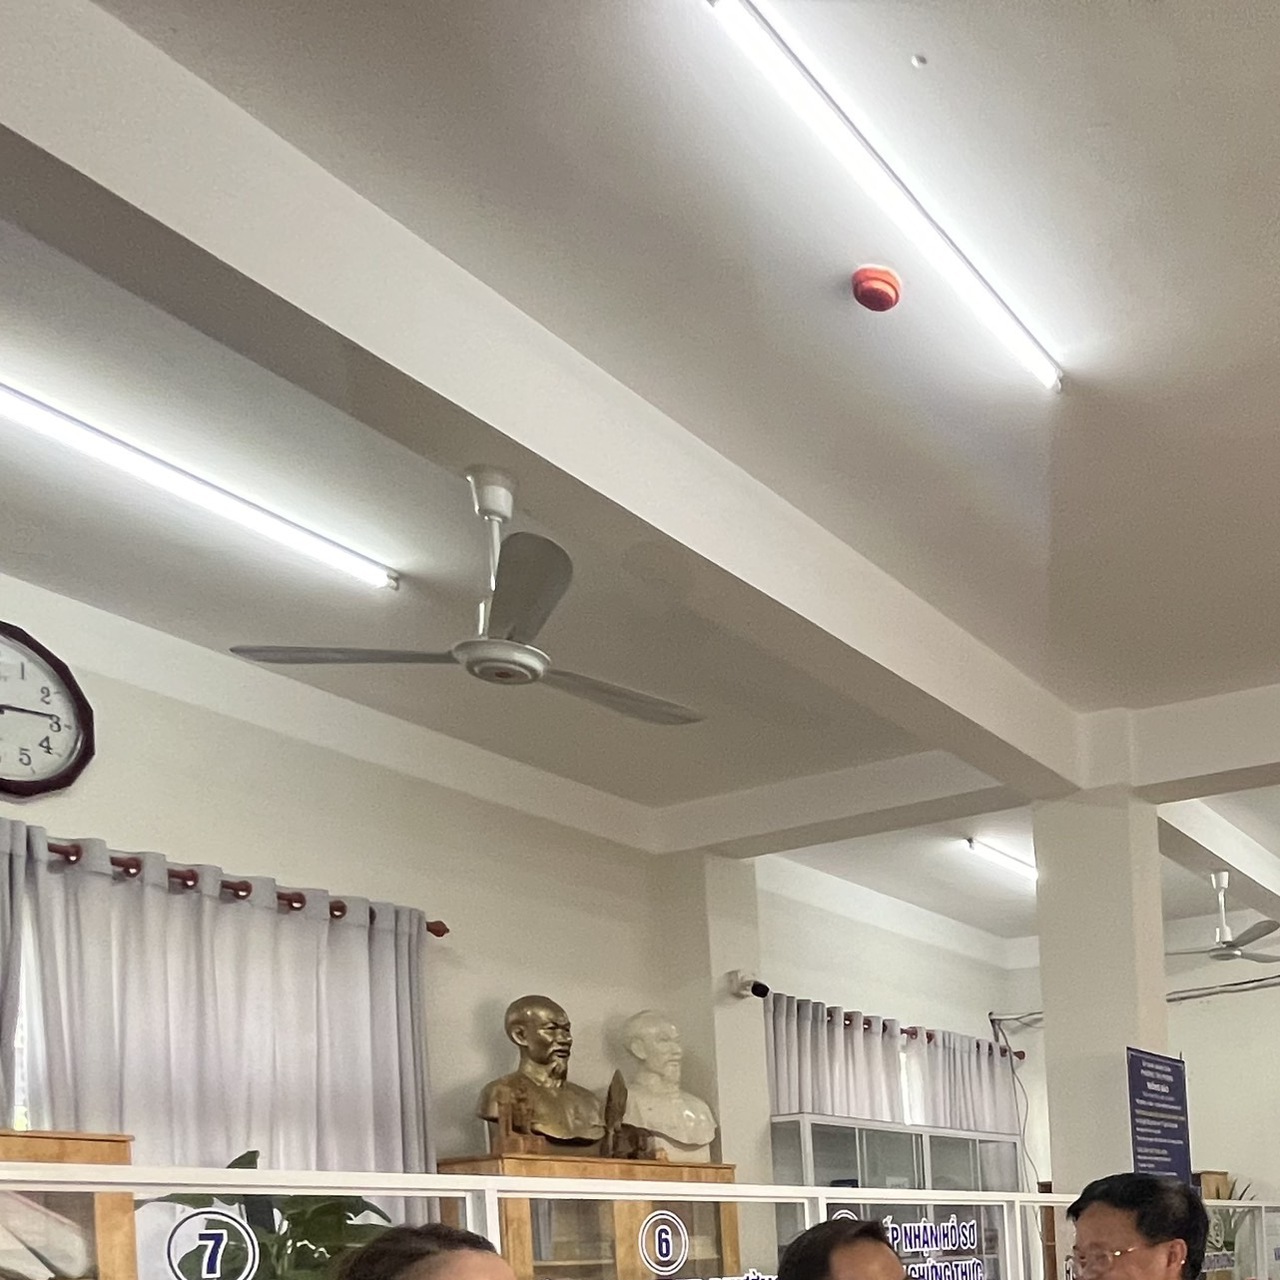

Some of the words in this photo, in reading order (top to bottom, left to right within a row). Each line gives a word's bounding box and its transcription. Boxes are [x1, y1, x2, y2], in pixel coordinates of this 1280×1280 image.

[40, 686, 51, 705] 2
[49, 714, 62, 733] 3
[38, 736, 53, 755] 4
[19, 747, 32, 766] 5
[656, 1226, 672, 1260] 6
[902, 1218, 939, 1256] NHẬN
[960, 1219, 976, 1250] SƠ
[199, 1230, 227, 1278] 7
